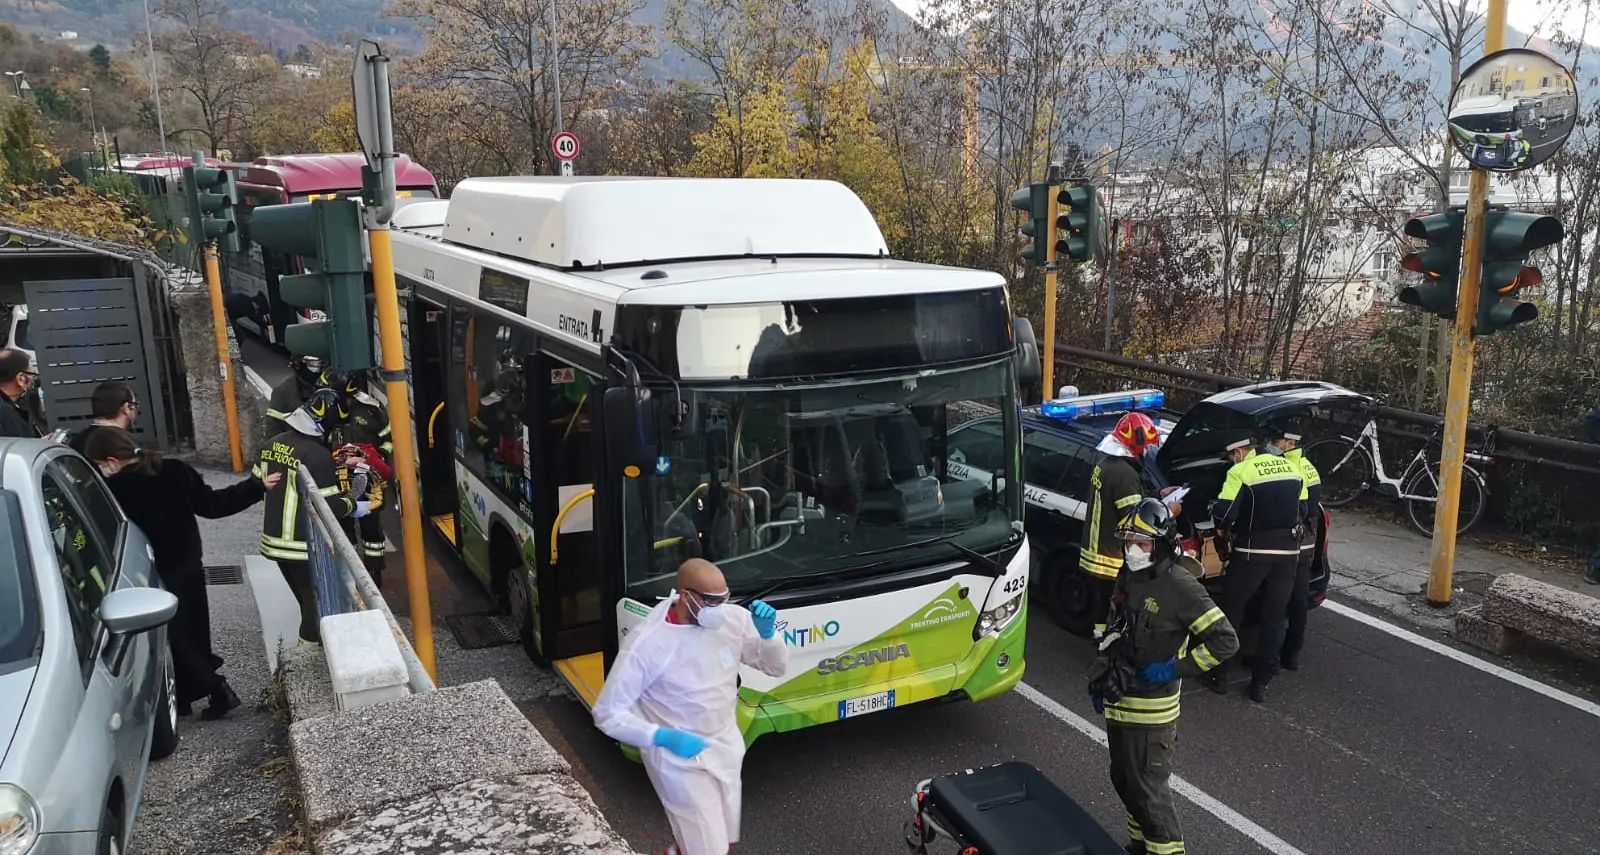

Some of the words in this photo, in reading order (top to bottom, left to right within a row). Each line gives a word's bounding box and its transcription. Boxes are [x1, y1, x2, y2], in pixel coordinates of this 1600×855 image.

[560, 140, 574, 153] 40
[559, 313, 588, 340] ENTRATA
[272, 442, 295, 456] VIGILI
[1253, 459, 1289, 469] POLIZIA
[1257, 465, 1293, 476] LOCALE
[1024, 486, 1048, 504] ALE
[1003, 575, 1025, 594] 423
[910, 617, 940, 629] TRENTINO
[783, 620, 841, 648] NTINO
[817, 643, 911, 676] SCANIA
